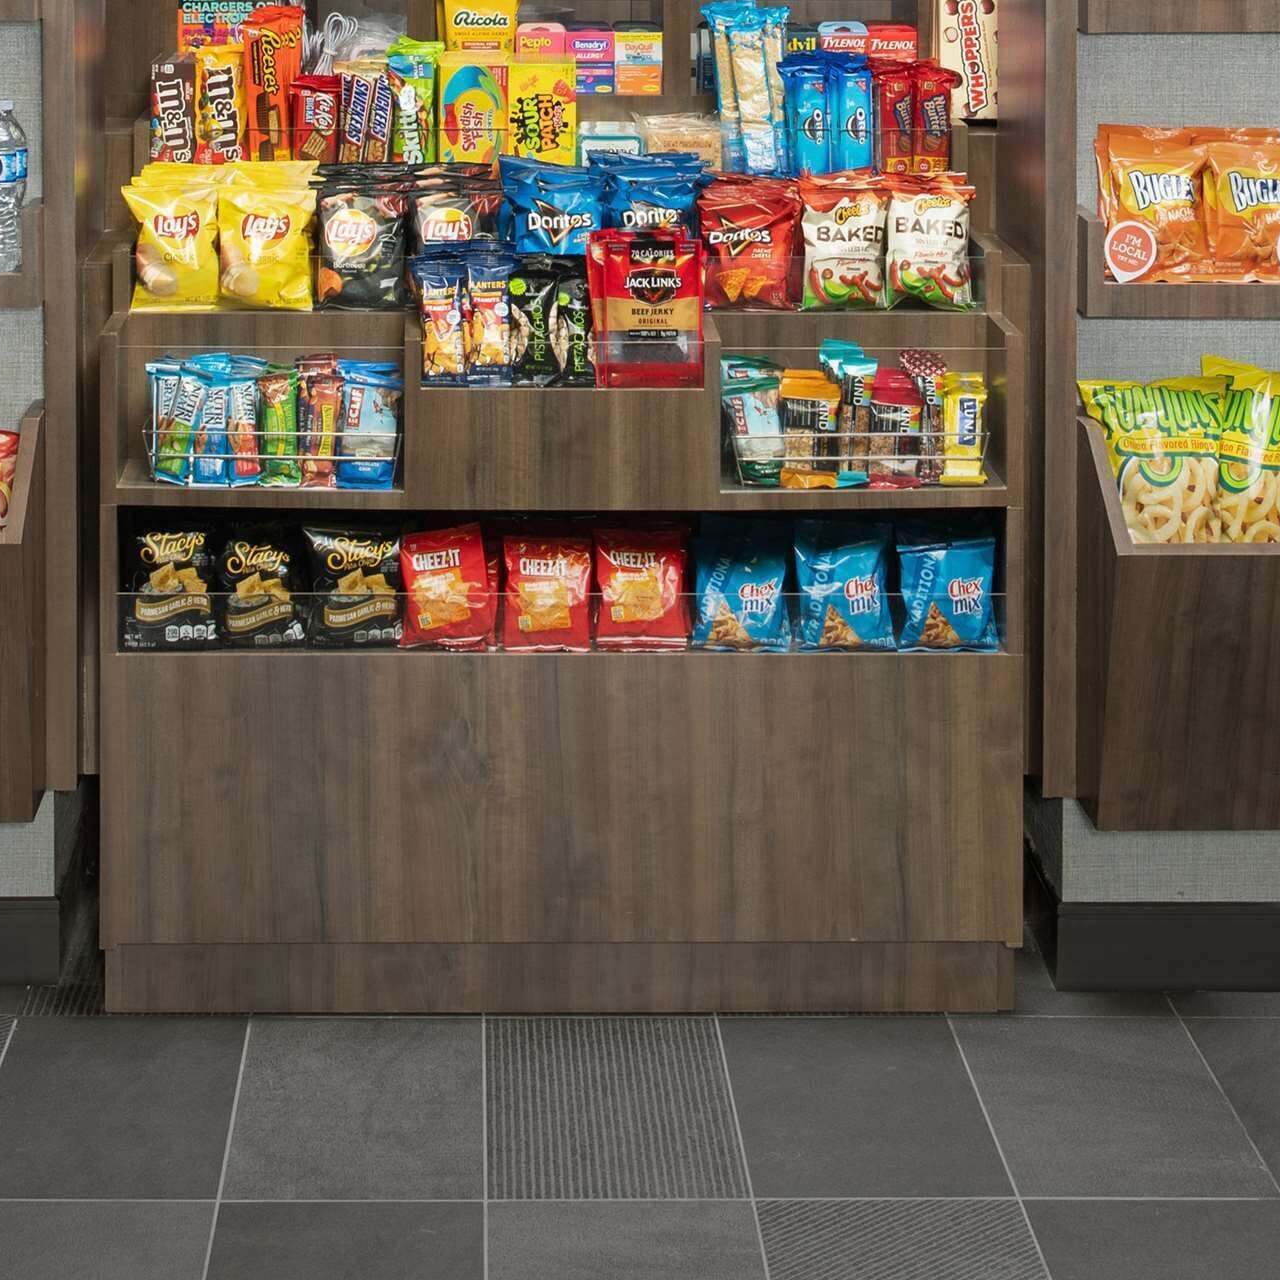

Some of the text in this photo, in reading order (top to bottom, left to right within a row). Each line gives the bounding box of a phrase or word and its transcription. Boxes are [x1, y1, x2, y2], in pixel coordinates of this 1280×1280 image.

[183, 2, 253, 12] CHARGERS
[453, 11, 508, 26] Ricola
[520, 36, 552, 48] Pepto
[574, 41, 608, 52] Benadryl
[786, 37, 815, 51] dvil
[822, 37, 866, 50] TYLENOL
[870, 39, 915, 51] TYLENOL
[959, 0, 987, 111] WHOPPERS
[347, 78, 369, 143] SNICKERS
[461, 102, 476, 152] Swedish
[471, 111, 484, 141] Fish
[523, 97, 541, 150] SOUR
[540, 94, 559, 151] PATCH
[157, 213, 197, 239] Lay's
[244, 216, 288, 239] Lay's
[528, 212, 592, 231] Doritos
[895, 216, 964, 240] BAKED
[709, 228, 771, 245] Doritos
[816, 225, 884, 244] BAKED
[1124, 234, 1142, 247] I'M
[1111, 243, 1148, 261] LOCAL
[470, 280, 506, 289] LANTERS
[624, 276, 650, 289] JACK
[632, 308, 674, 317] BEEF JERKY
[853, 375, 864, 406] KIND
[925, 375, 935, 406] KIND
[214, 389, 224, 425] NUTRI
[819, 401, 829, 430] KIND
[900, 407, 912, 434] KIND
[963, 400, 976, 442] LUNA
[141, 532, 205, 562] Stacy's
[740, 578, 778, 599] Chex
[845, 573, 878, 599] Chex
[949, 577, 983, 599] Chex
[744, 597, 773, 612] mix
[851, 595, 879, 614] mix
[954, 596, 982, 614] mix
